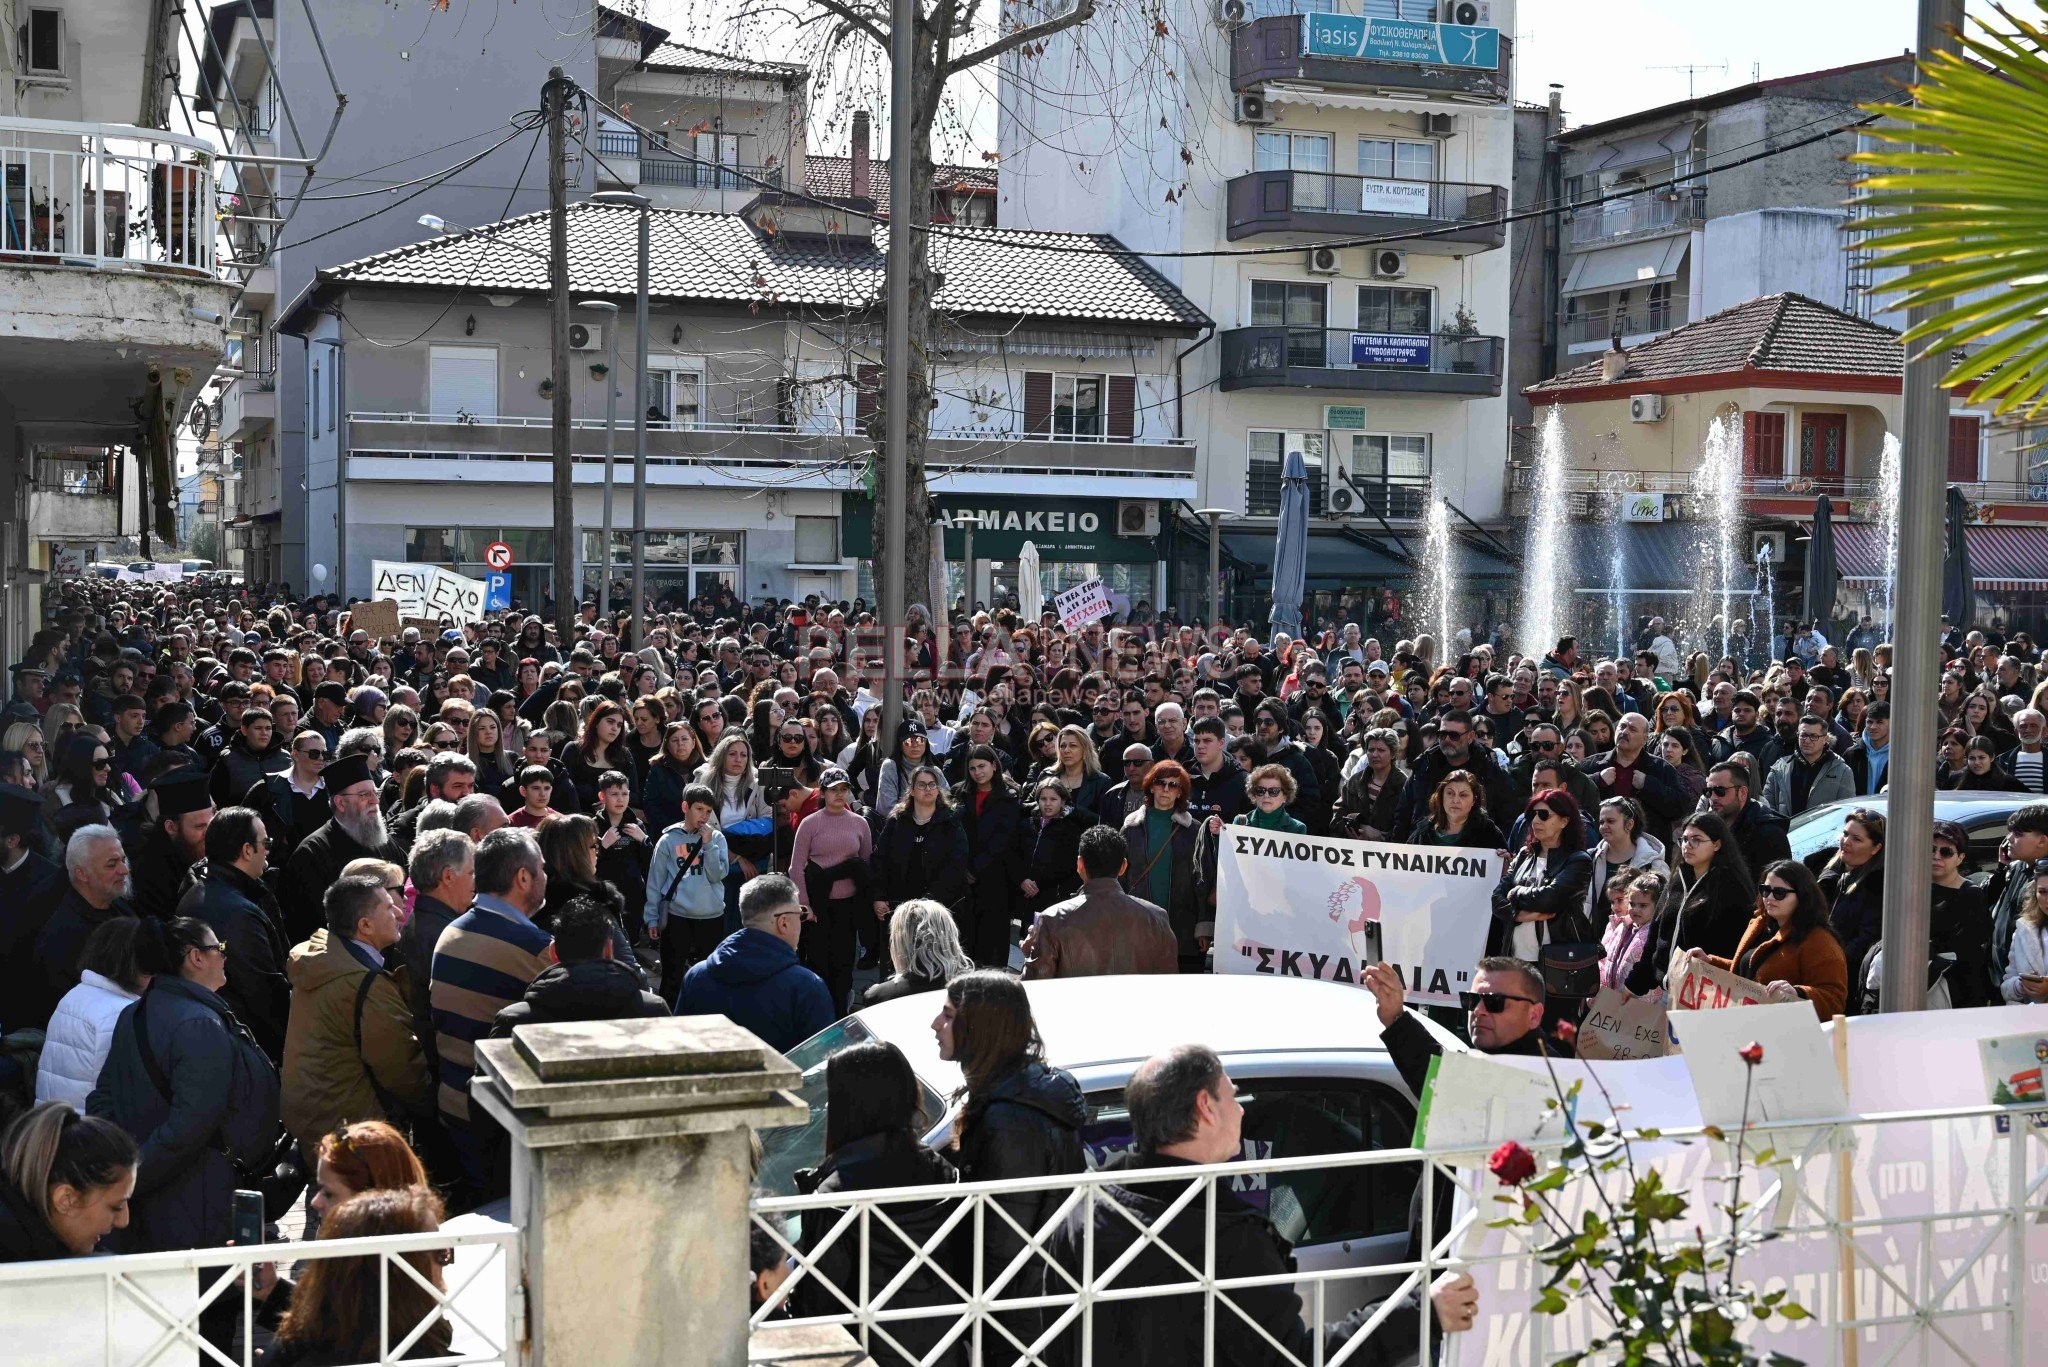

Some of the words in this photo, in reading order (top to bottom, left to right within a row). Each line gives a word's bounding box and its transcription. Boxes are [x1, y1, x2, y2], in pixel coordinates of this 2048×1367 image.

[1316, 22, 1357, 46] iasis
[1371, 25, 1436, 40] ΦΥΣΙΚΟΘΕΡΑΠΕΙΑ
[1366, 184, 1385, 194] ΕΥΣΤΡ.
[1393, 187, 1425, 197] ΚΟΥΤΣΑΚΗΣ
[938, 508, 1099, 533] ΑΡΜΑΚΕΙΟ
[376, 570, 426, 593] ΔΕΝ
[491, 576, 505, 592] P
[1235, 835, 1354, 867] ΣΥΛΛΟΓΟΣ
[1362, 850, 1487, 878] ΓΥΝΑΙΚΩΝ
[1589, 1011, 1622, 1033] ΔΕΝ
